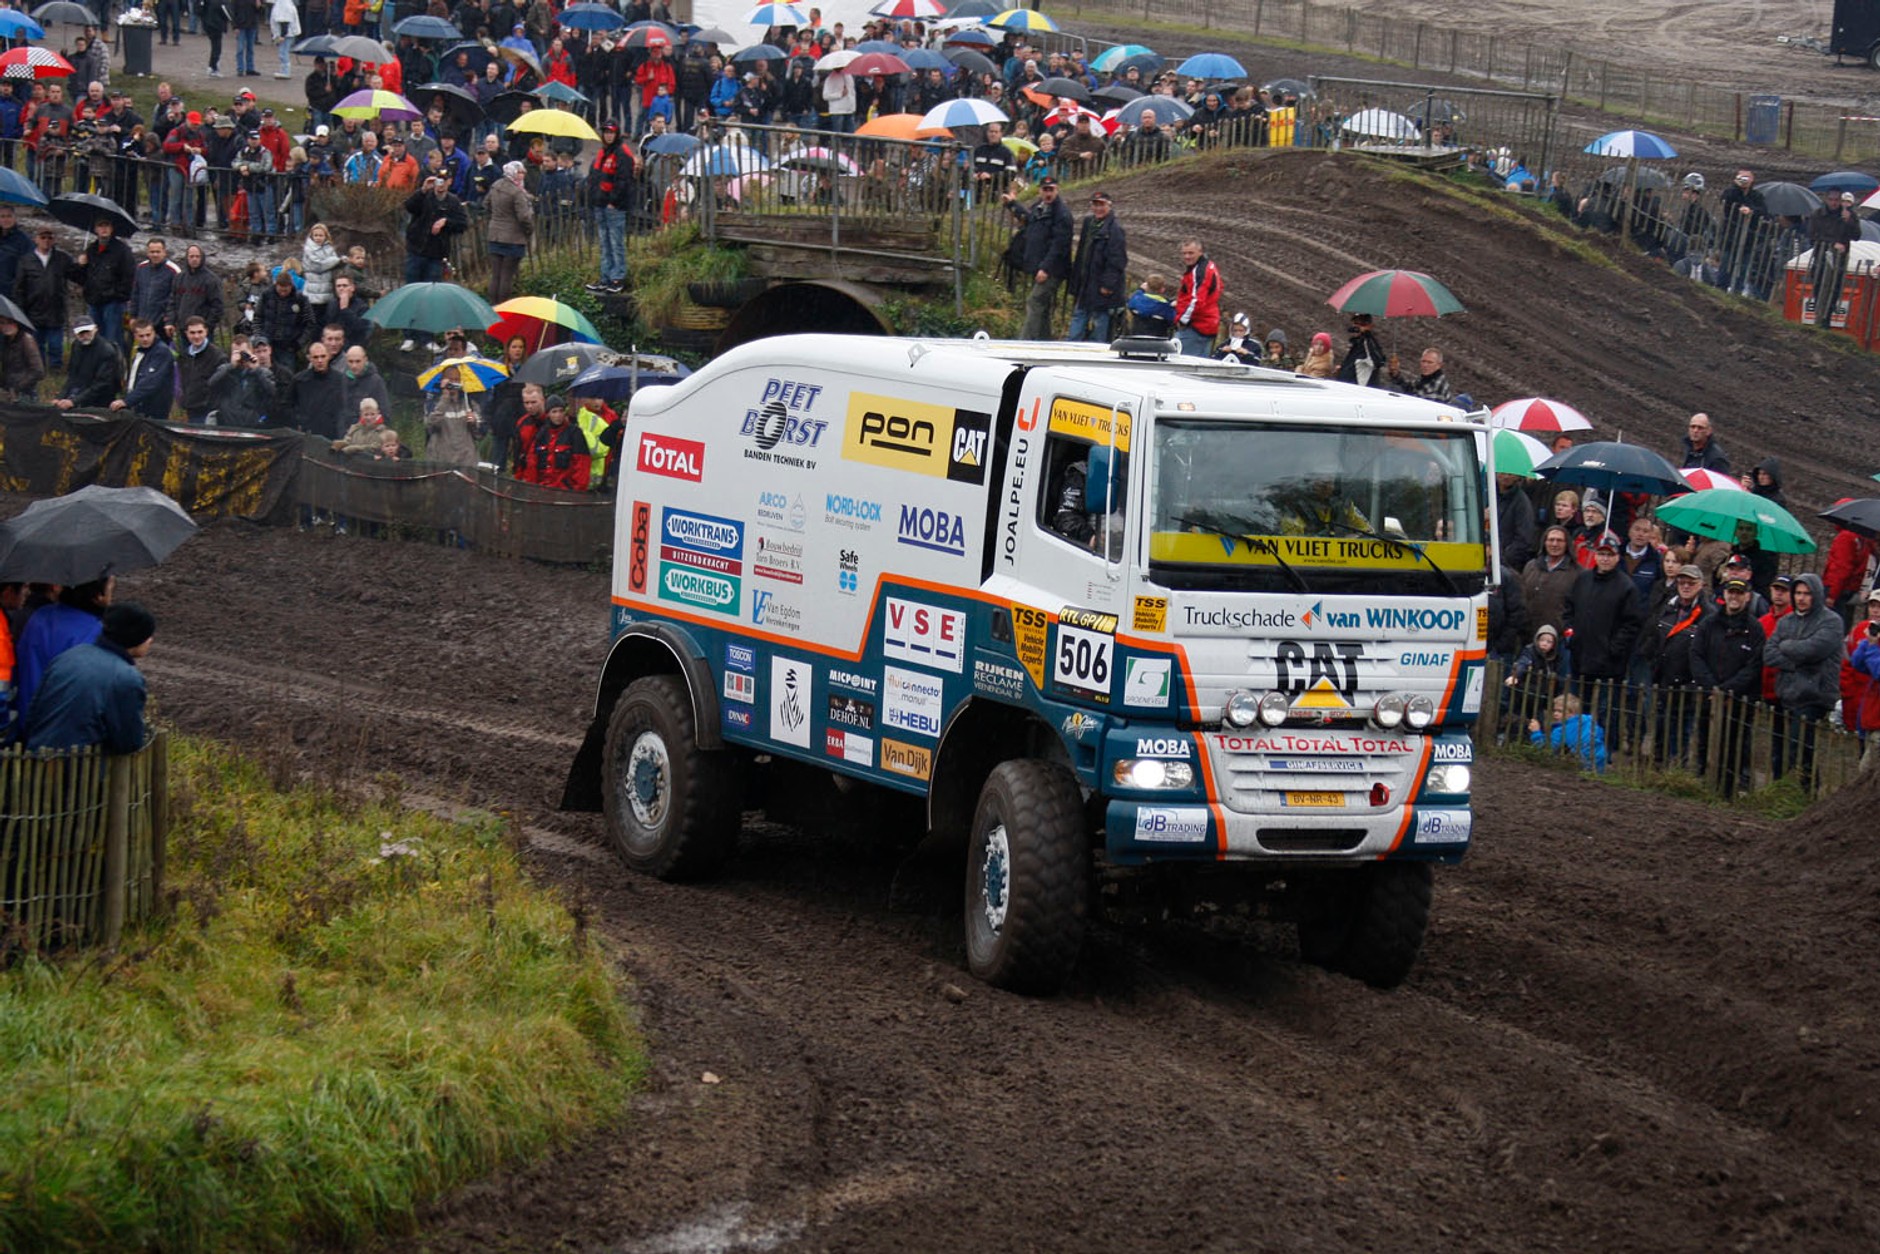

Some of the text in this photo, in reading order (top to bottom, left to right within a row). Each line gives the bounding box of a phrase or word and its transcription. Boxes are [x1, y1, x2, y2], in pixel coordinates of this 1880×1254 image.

[760, 378, 823, 411] PEET
[739, 402, 829, 450] BORST
[859, 411, 934, 444] pon
[1053, 408, 1068, 422] VAN
[1070, 412, 1090, 427] VLIET
[642, 439, 700, 476] TOTAL
[952, 427, 986, 467] CAT
[744, 449, 817, 470] BANDEN TECHNIEK BV
[759, 491, 787, 509] ARCO
[826, 493, 882, 522] NORD-LOCK
[1005, 438, 1029, 567] JOALPE.EU
[671, 517, 734, 544] WORKTRANS
[899, 504, 965, 548] MOBA
[672, 550, 729, 571] UITZENDKRACHT
[840, 549, 859, 564] Safe
[1285, 540, 1335, 557] VLIET
[1337, 541, 1403, 560] TRUCKS
[840, 562, 858, 573] Wheels
[671, 572, 729, 599] WORKBUS
[766, 600, 801, 620] Van Egdom
[1136, 598, 1165, 608] TSS
[889, 603, 955, 642] VSE
[1014, 607, 1047, 628] TSS
[1060, 608, 1096, 627] RTL GP
[1184, 606, 1295, 628] Truckschade
[1326, 612, 1361, 628] van
[1366, 608, 1465, 630] WINKOOP
[1020, 642, 1043, 656] Mobility
[1024, 633, 1044, 645] Vehicle
[1022, 653, 1043, 665] Experts
[1060, 634, 1108, 684] 506
[1400, 652, 1450, 666] GINAF
[829, 669, 877, 690] MICPOINT
[973, 670, 1023, 692] RECLAME
[974, 660, 1024, 681] RIJKEN
[1274, 641, 1365, 707] CAT
[829, 708, 871, 729] DEHOF.NL
[899, 710, 939, 733] HEBU
[1136, 739, 1190, 754] MOBA
[1214, 735, 1414, 752] TOTAL TOTAL TOTAL
[1434, 744, 1472, 759] MOBA
[884, 743, 905, 765] Van
[906, 749, 928, 774] Dijk
[1167, 824, 1206, 833] TRADING
